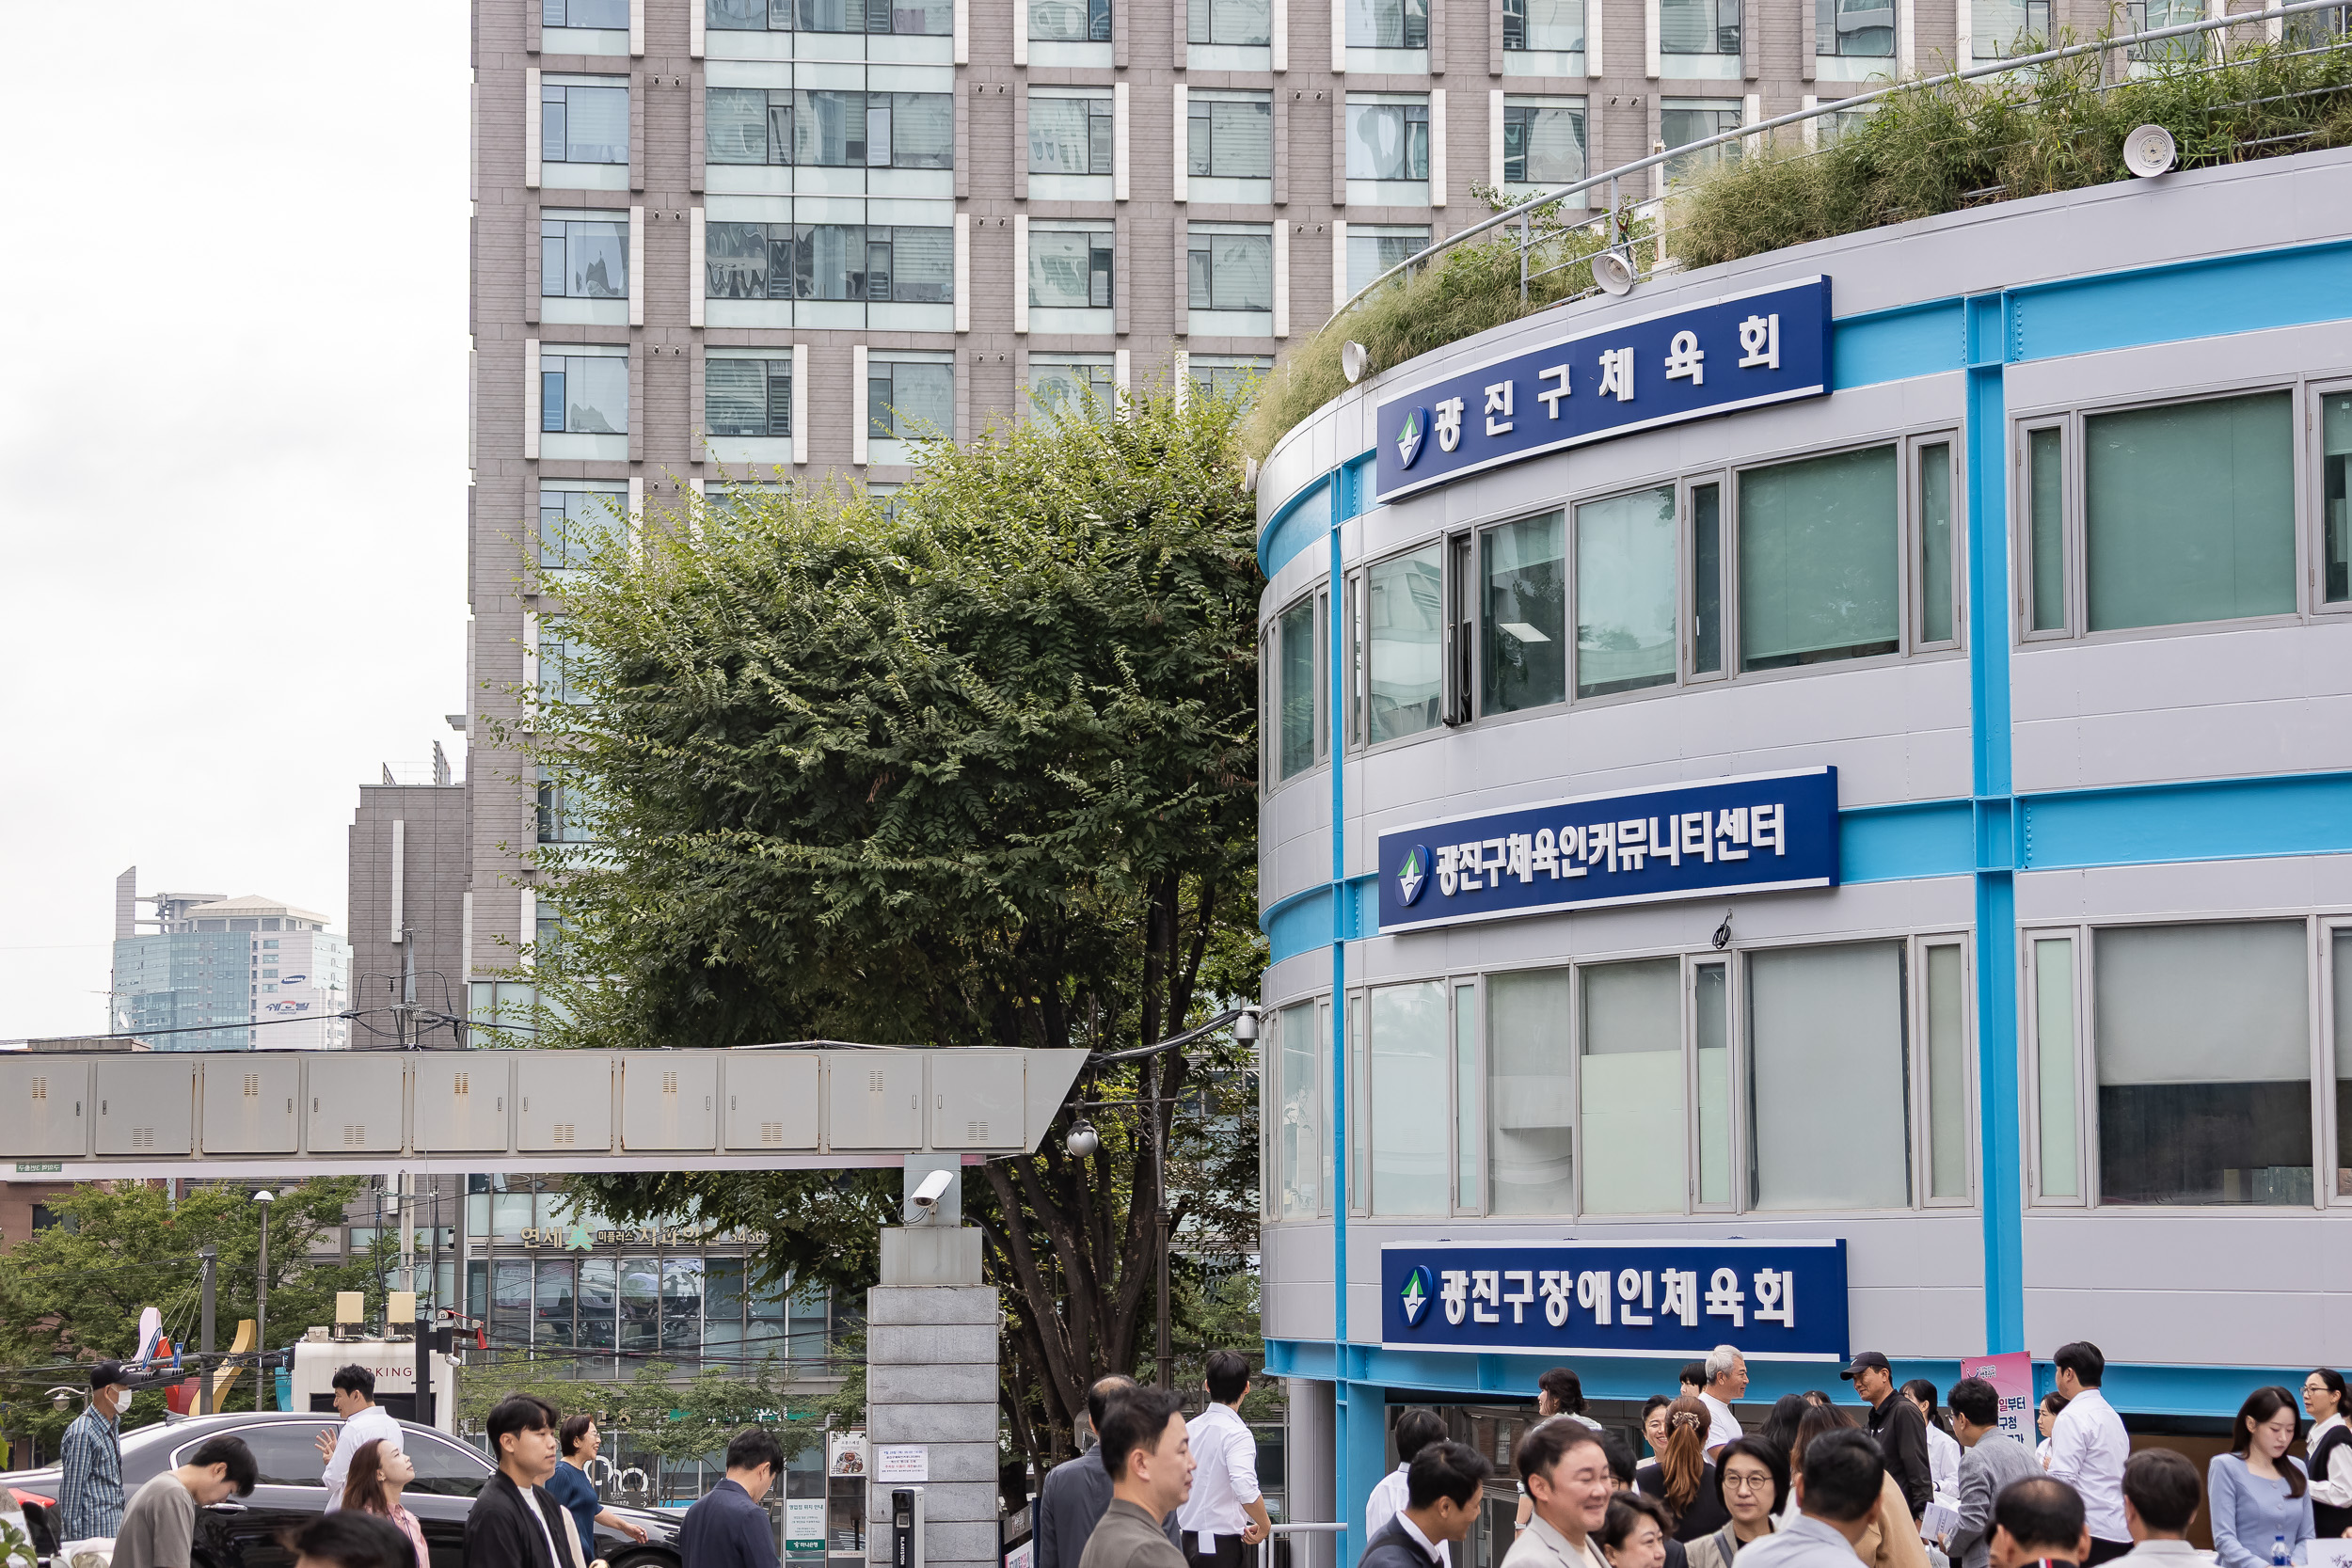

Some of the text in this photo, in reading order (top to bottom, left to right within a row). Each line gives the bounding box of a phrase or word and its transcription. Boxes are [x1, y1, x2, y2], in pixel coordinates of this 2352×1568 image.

[1436, 803, 1786, 897] 광진구체육인커뮤니티센터
[597, 1230, 634, 1243] 미플러스
[1440, 1267, 1795, 1328] 광진구장애인체육회
